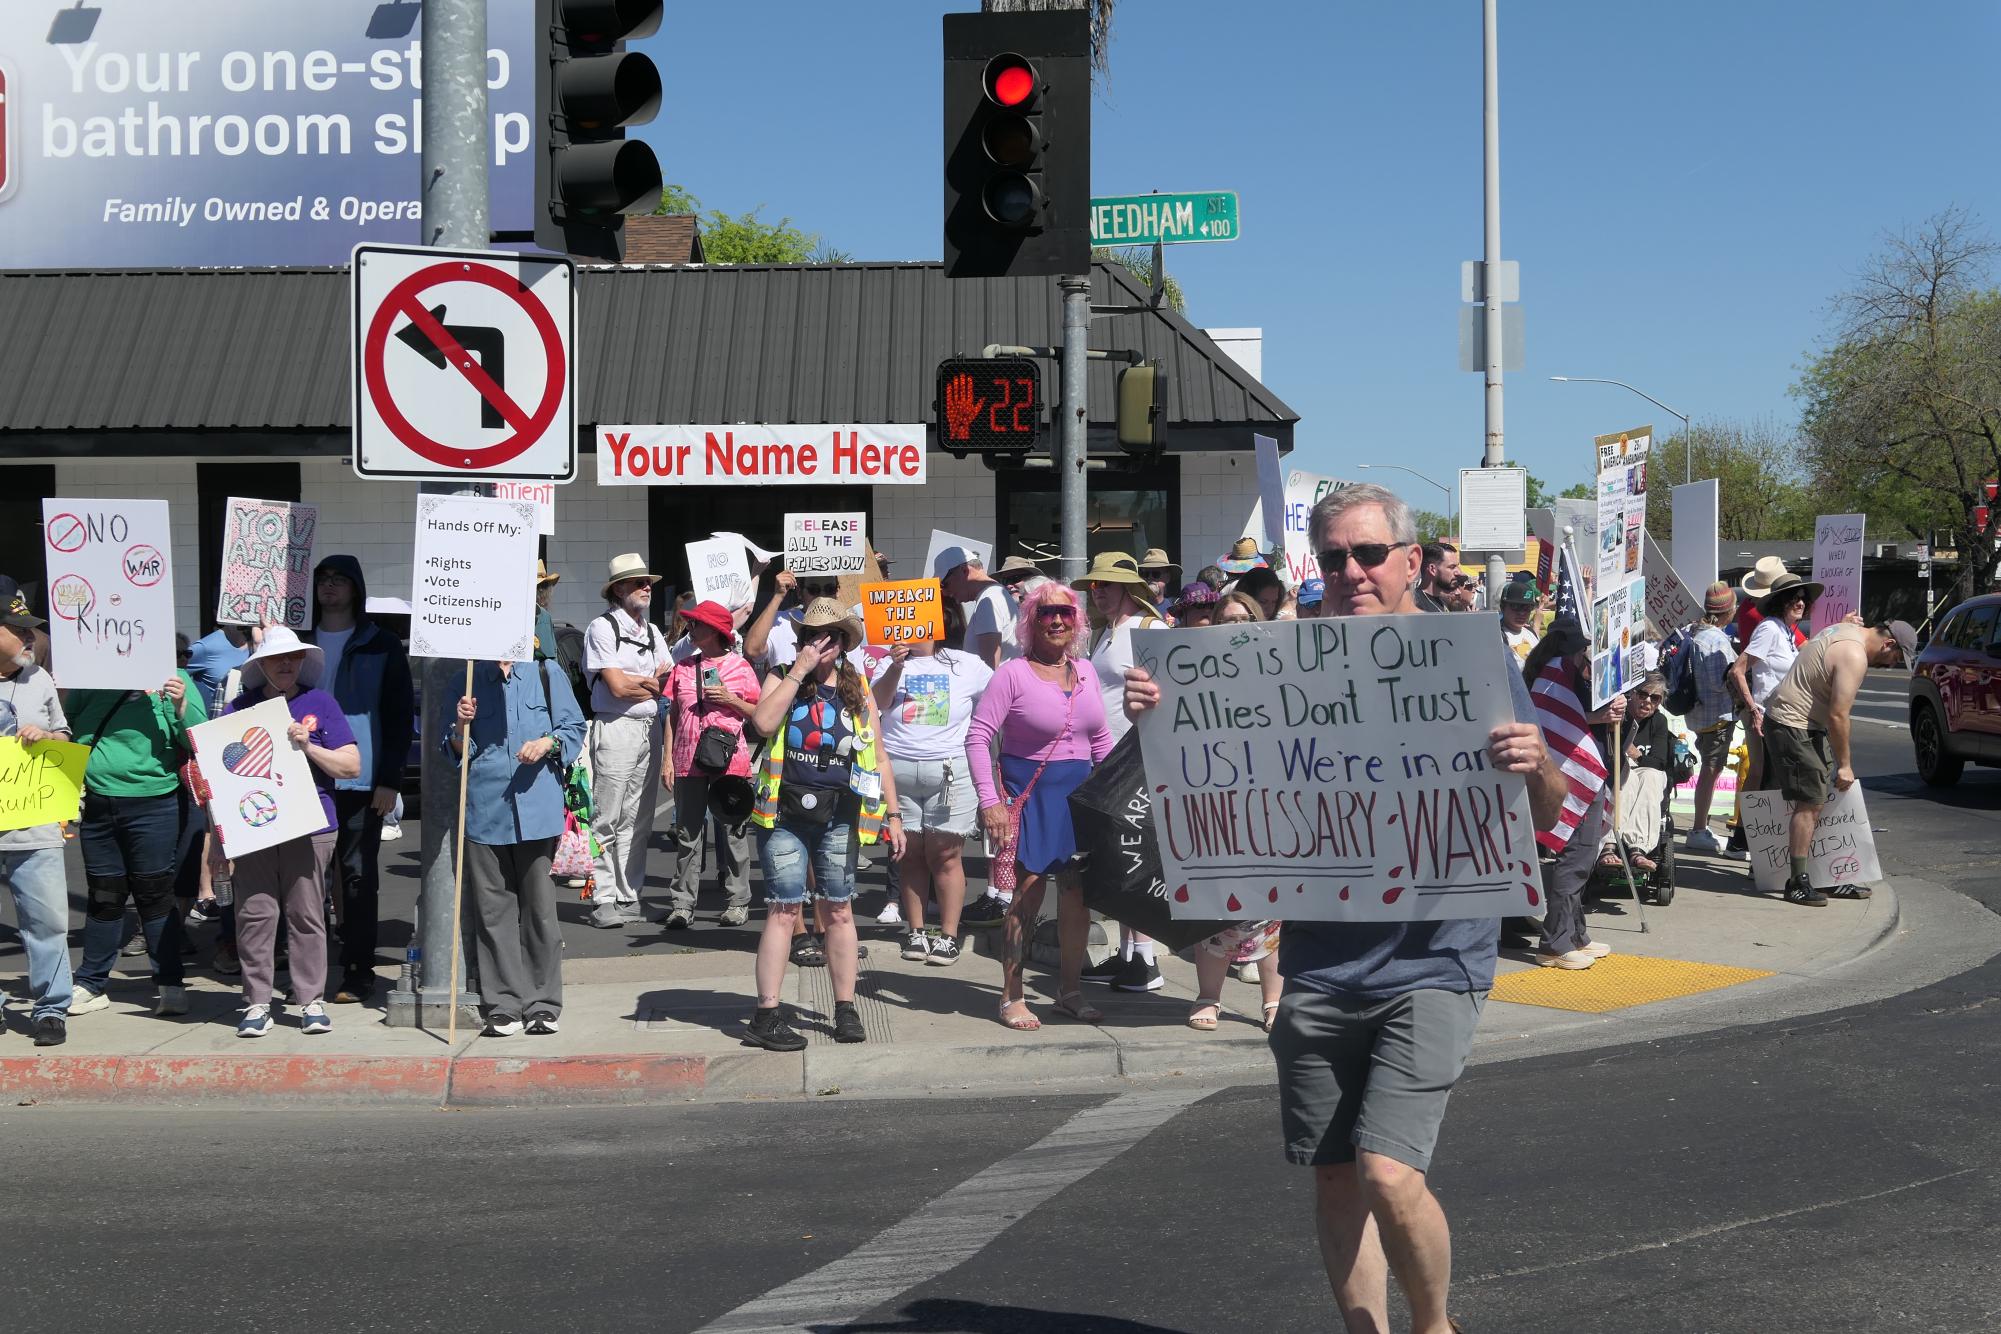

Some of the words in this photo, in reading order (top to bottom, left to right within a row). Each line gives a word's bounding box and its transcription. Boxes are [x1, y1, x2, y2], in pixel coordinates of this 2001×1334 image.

[56, 42, 200, 93] Your
[221, 41, 510, 92] one-stp
[42, 101, 352, 158] bathroom
[103, 197, 196, 227] Family
[204, 195, 302, 221] Owned
[310, 196, 329, 221] &
[339, 198, 422, 226] Opera
[1210, 219, 1231, 237] 100
[990, 378, 1033, 432] 22
[604, 432, 691, 477] Your
[705, 431, 818, 476] Name
[832, 430, 920, 476] Here
[87, 513, 128, 544] NO
[234, 508, 315, 546] YOU
[428, 519, 470, 532] Hands
[473, 521, 495, 534] Off
[498, 523, 521, 537] My:
[794, 519, 858, 532] RELEASE
[788, 536, 818, 552] ALL
[823, 535, 852, 547] THE
[127, 560, 160, 577] WAR
[431, 556, 472, 571] Rights
[706, 551, 730, 570] NO
[785, 555, 829, 572] FILES
[831, 555, 865, 571] NOW
[253, 569, 278, 594] A
[430, 576, 460, 588] Vote
[1824, 585, 1835, 598] US
[429, 594, 502, 611] Citizenship
[869, 587, 935, 605] IMPEACH
[221, 592, 307, 626] KING
[428, 613, 472, 626] Uterus
[885, 606, 916, 621] THE
[1659, 594, 1689, 636] PEACE
[77, 600, 145, 658] Kings
[883, 621, 934, 641] PEDO!
[1166, 644, 1240, 685] Gas
[1253, 637, 1284, 676] is
[1295, 623, 1350, 673] UP!
[1370, 625, 1454, 670] Our
[1173, 690, 1272, 733] Allies
[1377, 676, 1478, 724] Trust
[1181, 740, 1255, 788] US!
[1400, 741, 1441, 779] in
[1745, 793, 1772, 815] Say
[1164, 787, 1377, 862] UNNECESSARY
[1396, 783, 1514, 880] WAR!
[1121, 833, 1144, 875] WE
[1833, 861, 1860, 875] ICE
